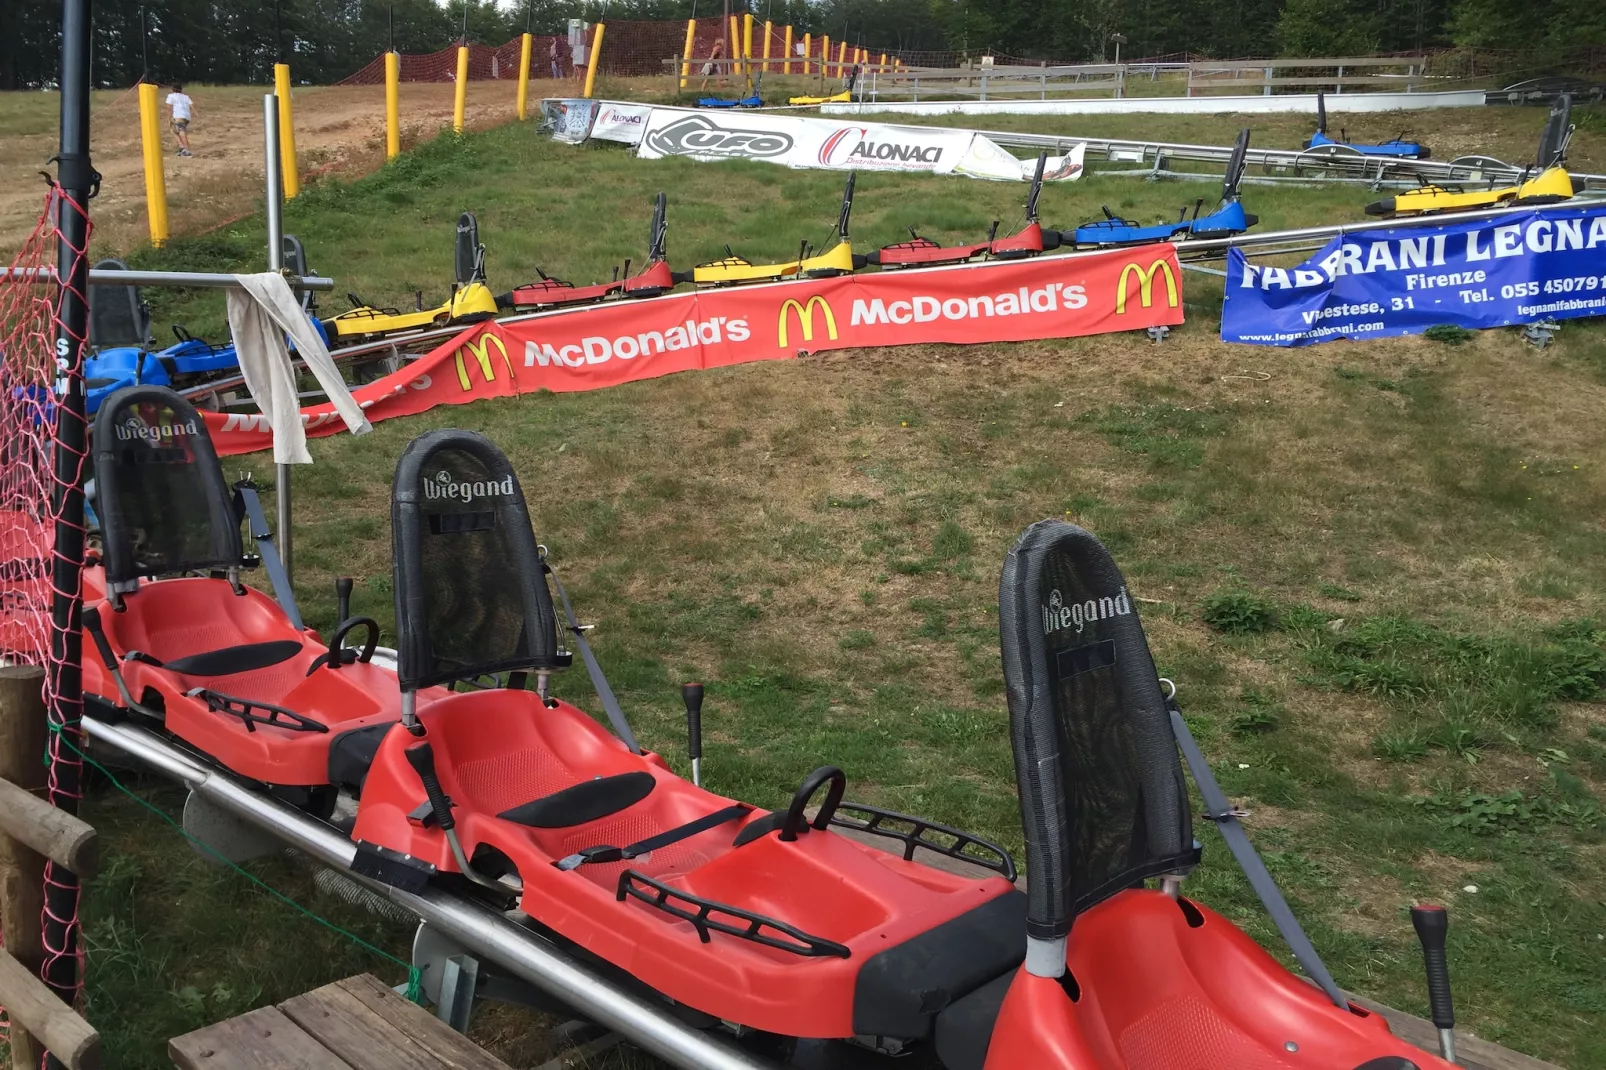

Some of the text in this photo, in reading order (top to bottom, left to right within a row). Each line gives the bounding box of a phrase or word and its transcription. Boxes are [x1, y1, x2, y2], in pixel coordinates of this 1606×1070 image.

[683, 131, 786, 151] UFO
[1466, 216, 1606, 262] LEGNA
[1391, 296, 1415, 311] 31
[1459, 288, 1495, 304] Tel.
[1501, 281, 1540, 299] 055
[1406, 269, 1486, 291] Firenze
[850, 282, 1089, 326] McDonald's
[524, 316, 751, 368] McDonald's
[115, 418, 199, 442] Wiegand
[423, 470, 515, 503] Wiegand
[1041, 586, 1131, 635] Wiegand
